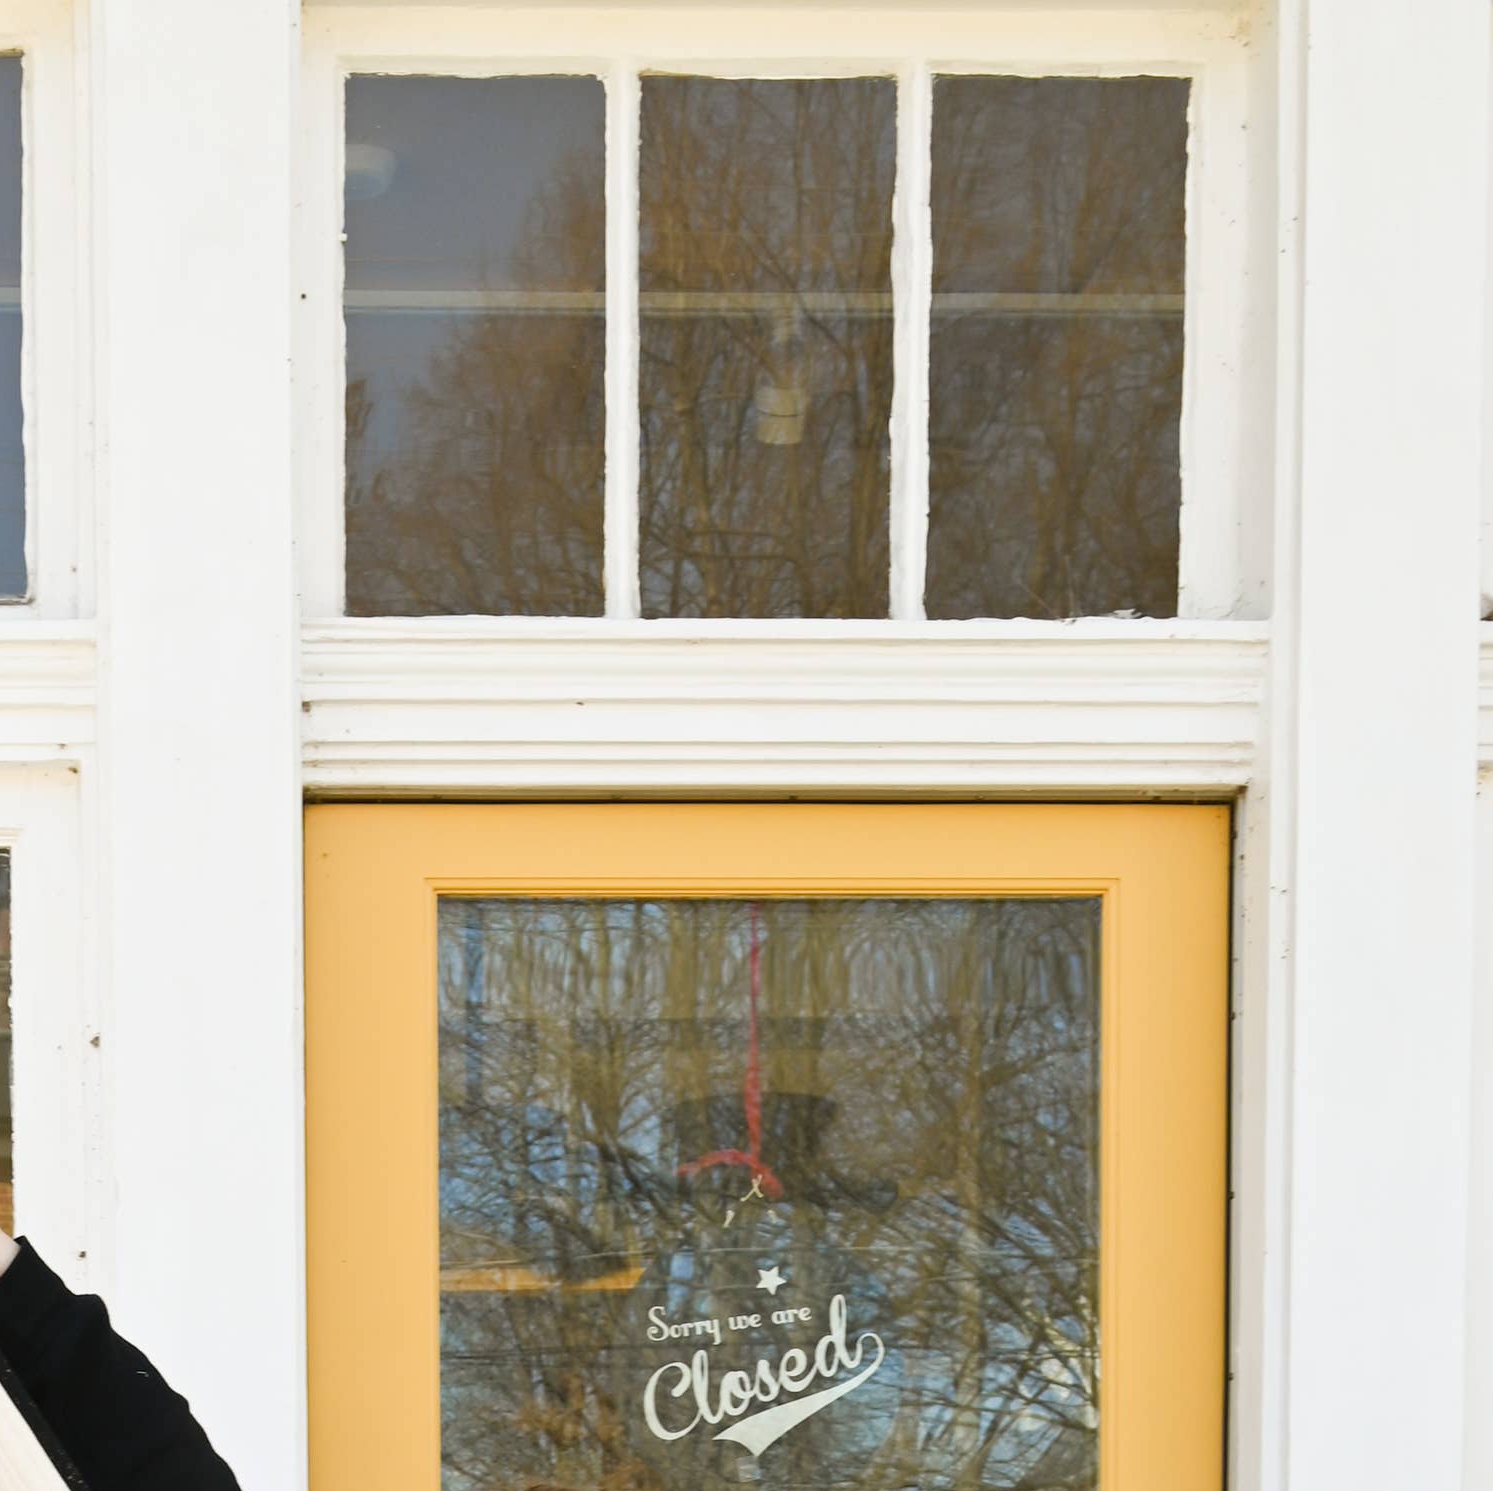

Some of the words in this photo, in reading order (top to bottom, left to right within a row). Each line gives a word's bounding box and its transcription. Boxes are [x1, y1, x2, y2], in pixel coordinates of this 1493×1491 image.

[643, 1293, 863, 1441] Closed
[646, 1305, 722, 1346] Sorry
[727, 1313, 762, 1331] we
[771, 1306, 812, 1326] are
